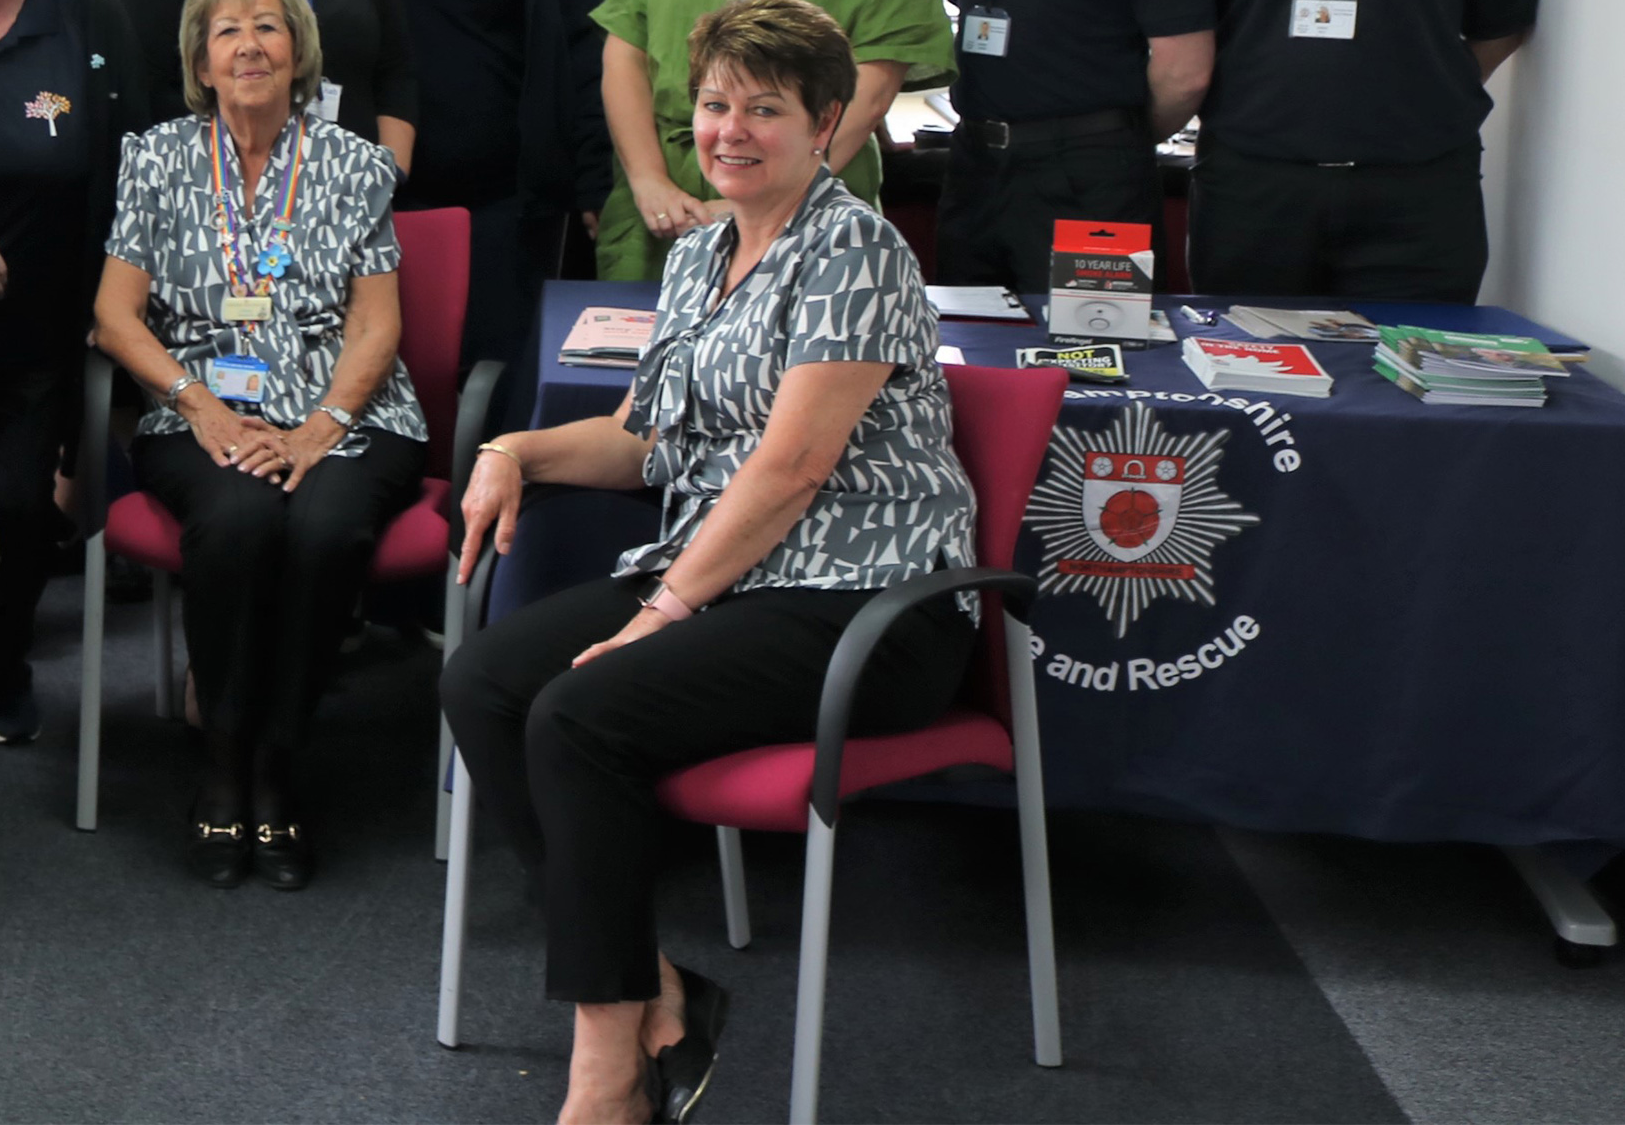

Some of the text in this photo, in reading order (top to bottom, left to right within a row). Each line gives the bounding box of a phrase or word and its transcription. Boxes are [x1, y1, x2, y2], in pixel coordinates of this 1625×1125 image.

[1075, 259, 1133, 272] 10 YEAR LIFE
[1057, 349, 1095, 360] NOT
[1063, 389, 1302, 473] amptonshire
[1046, 614, 1261, 692] and Rescue
